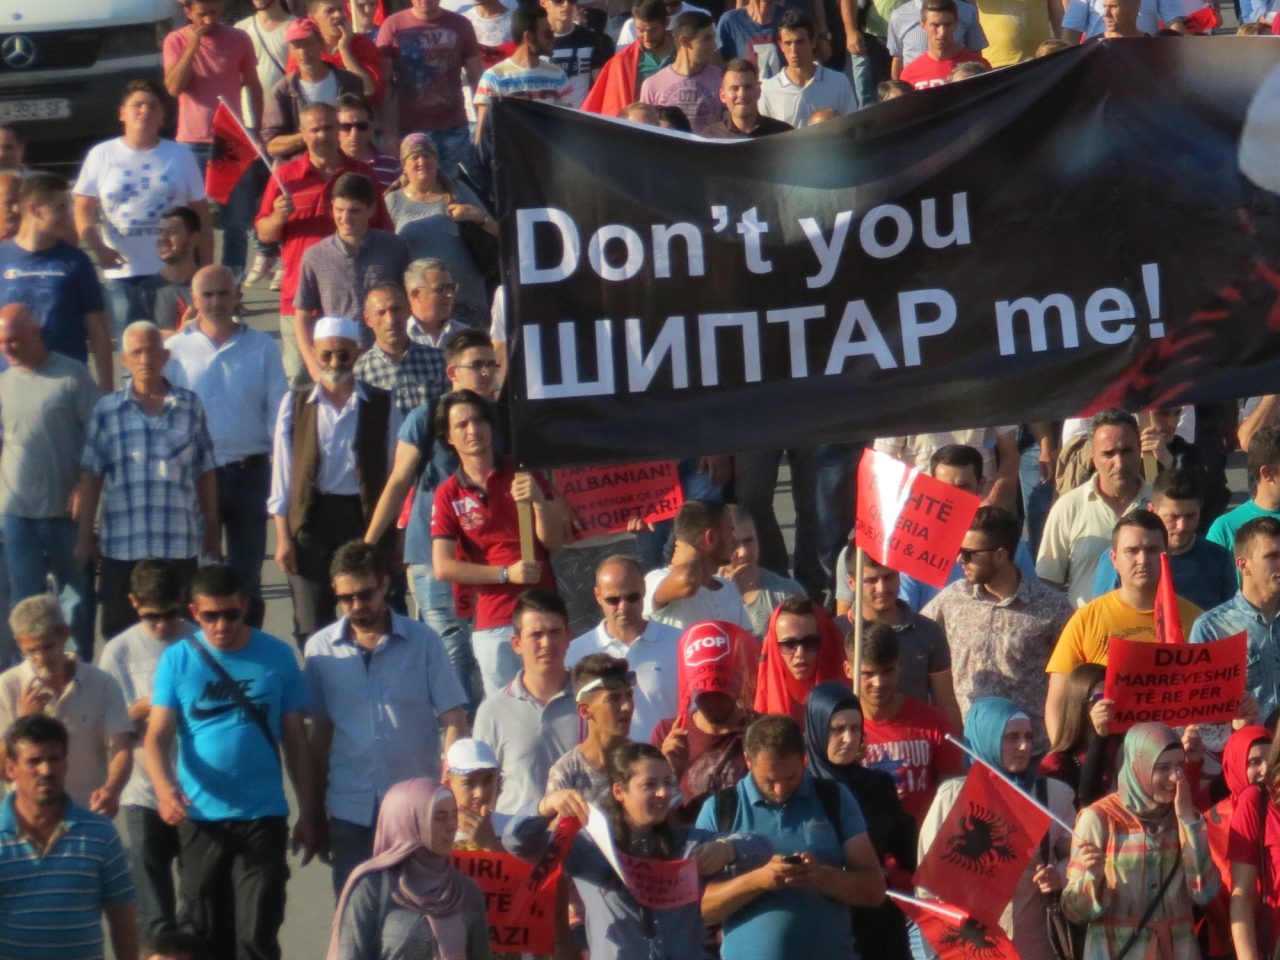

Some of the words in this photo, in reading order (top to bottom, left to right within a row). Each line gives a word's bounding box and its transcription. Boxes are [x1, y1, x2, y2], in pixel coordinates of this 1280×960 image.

[516, 205, 773, 286] Don't
[799, 191, 972, 289] you
[523, 288, 958, 401] ШИПТАР
[995, 262, 1166, 356] me!
[563, 463, 672, 497] ALBANIAN!
[577, 497, 679, 529] HQIPTAR!
[1154, 648, 1211, 667] DUA
[1161, 690, 1182, 703] RE
